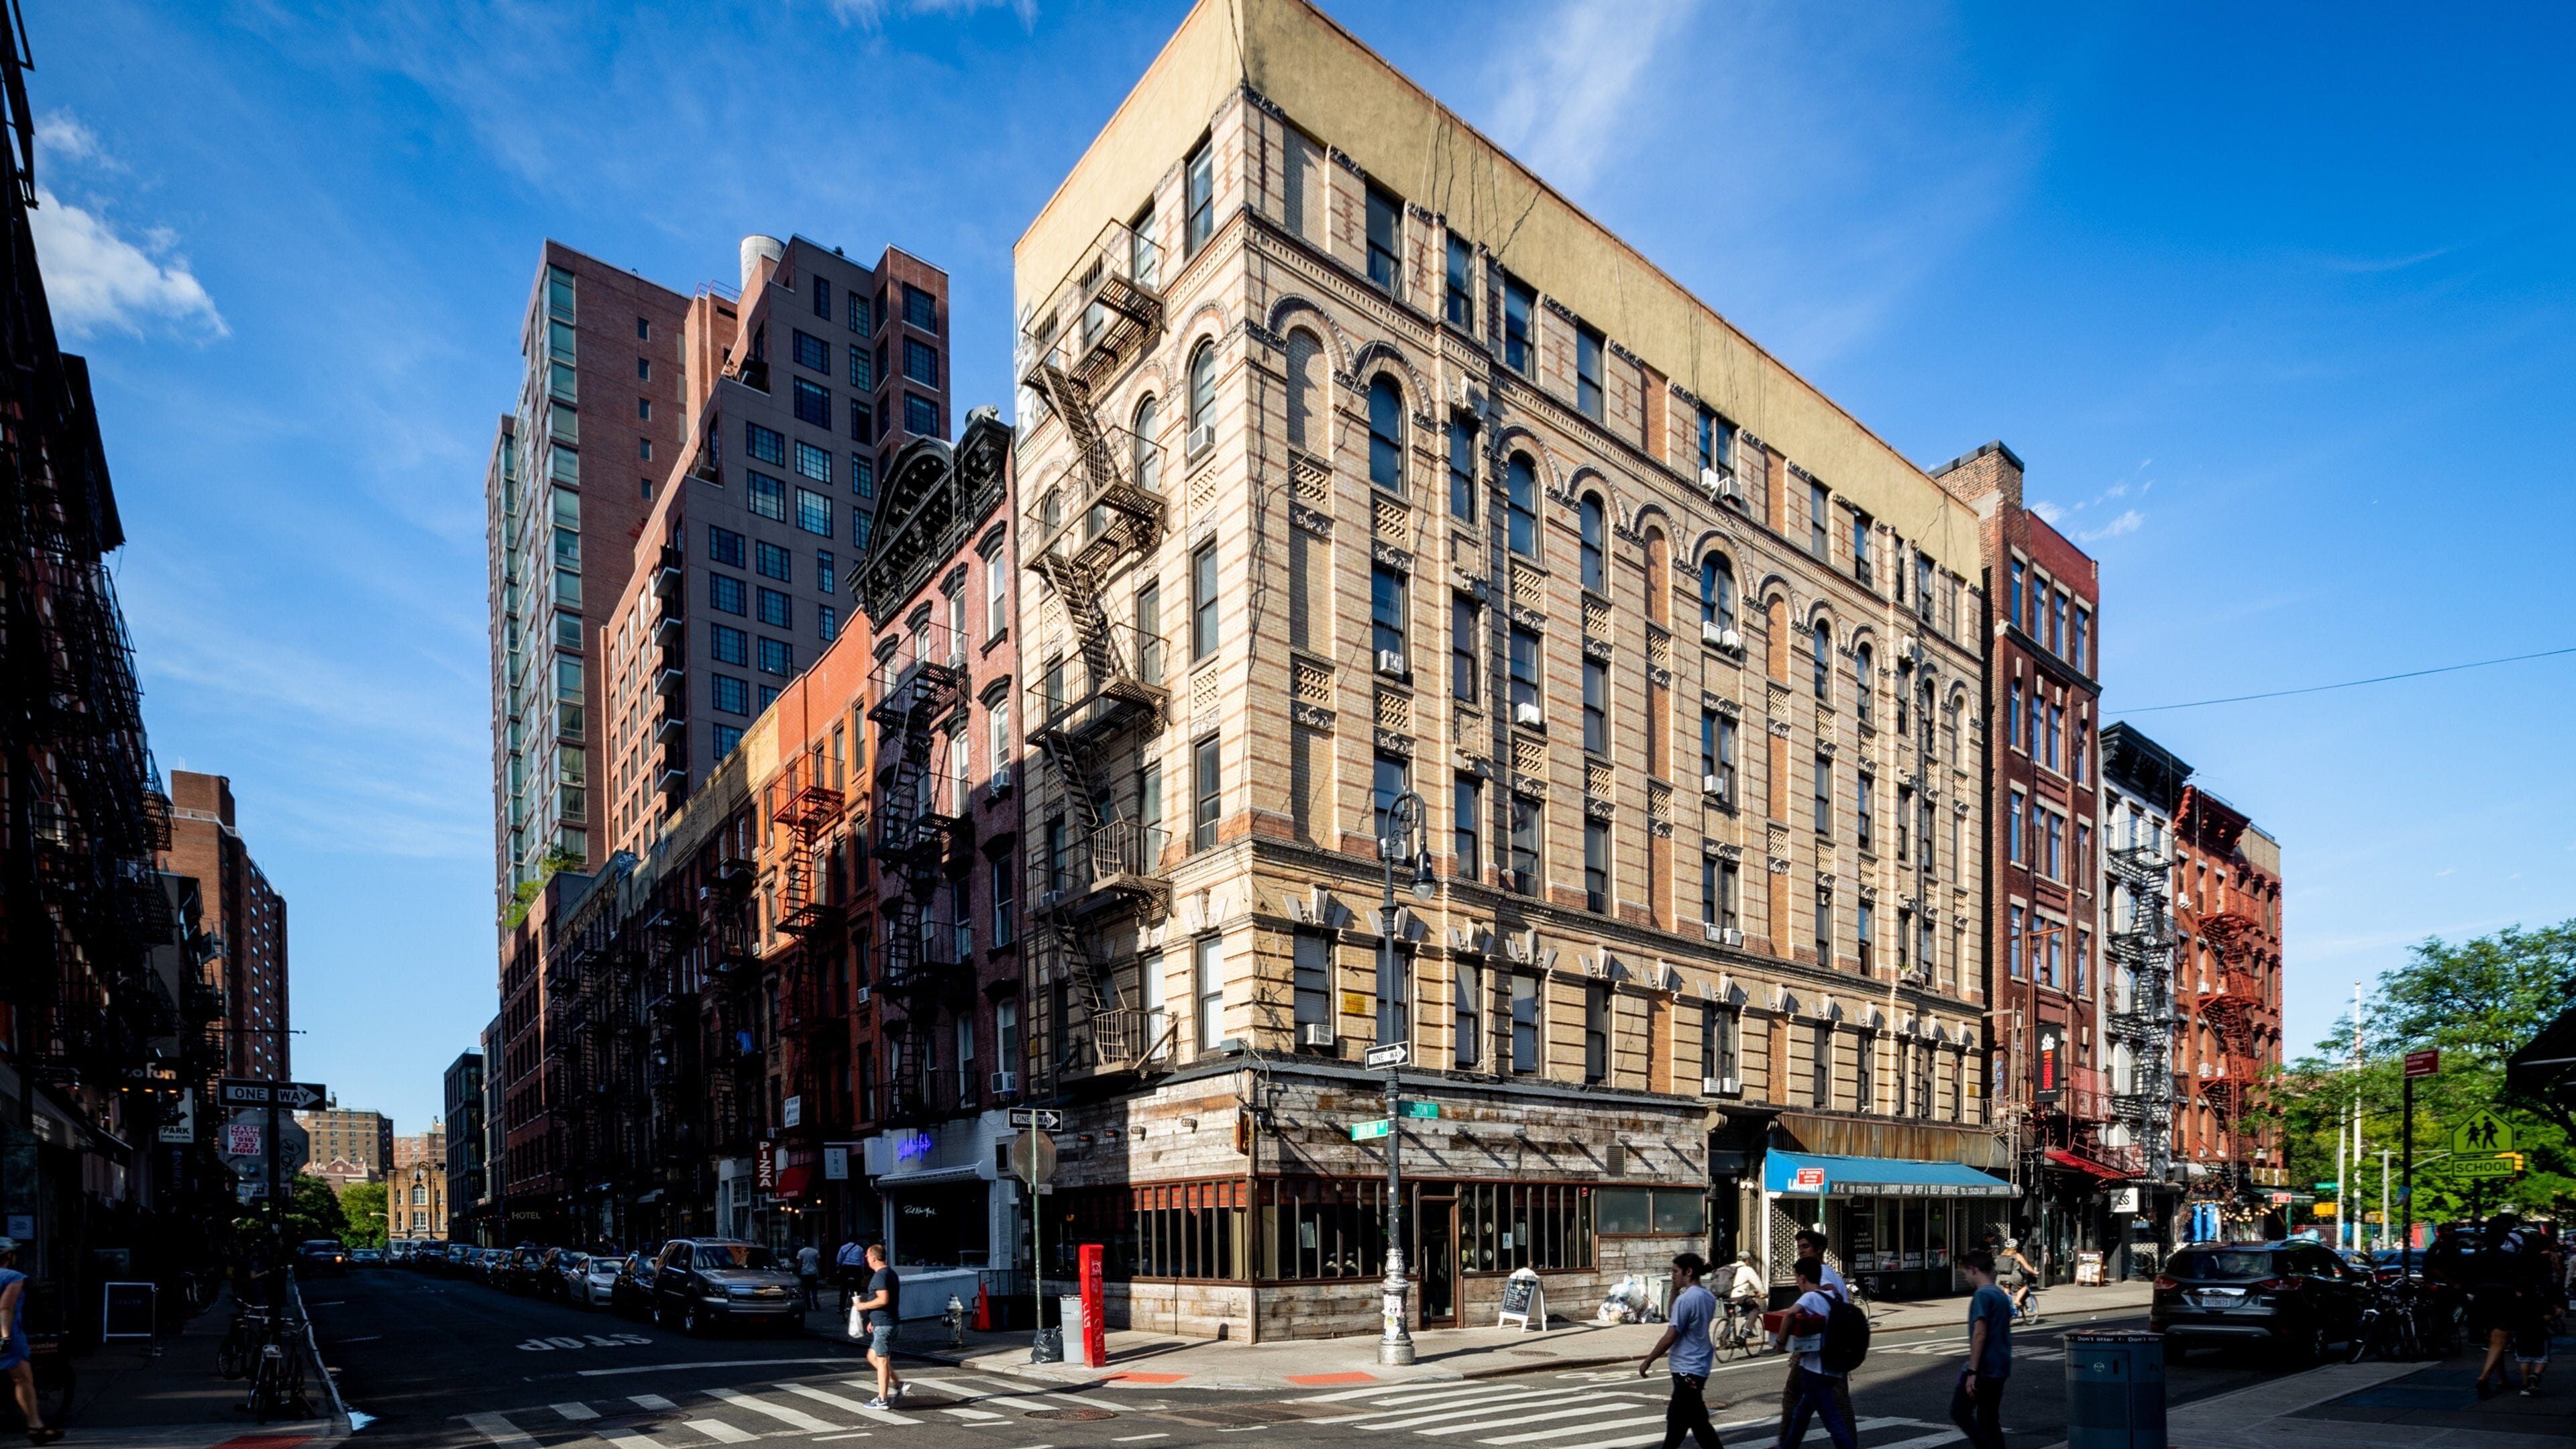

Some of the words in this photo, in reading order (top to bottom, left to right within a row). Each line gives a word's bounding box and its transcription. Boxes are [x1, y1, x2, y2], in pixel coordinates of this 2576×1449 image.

[1372, 1054, 1385, 1063] ONE
[1389, 1050, 1402, 1059] WAY
[146, 1062, 177, 1080] Fun
[235, 1088, 265, 1099] ONE
[279, 1090, 310, 1102] WAY
[1016, 1115, 1031, 1123] ONE
[1036, 1116, 1053, 1125] WAY
[1355, 1123, 1377, 1138] LUDLOW
[759, 1141, 772, 1187] PIZZA
[2456, 1162, 2511, 1173] SCHOOL
[1881, 1185, 1901, 1194] LAUNDRY
[1902, 1185, 1914, 1194] DROP
[1915, 1185, 1924, 1194] OFF
[1930, 1186, 1940, 1194] SELF
[1941, 1186, 1958, 1195] SERVICE
[512, 1211, 542, 1220] HOTEL
[515, 1334, 653, 1351] STOP
